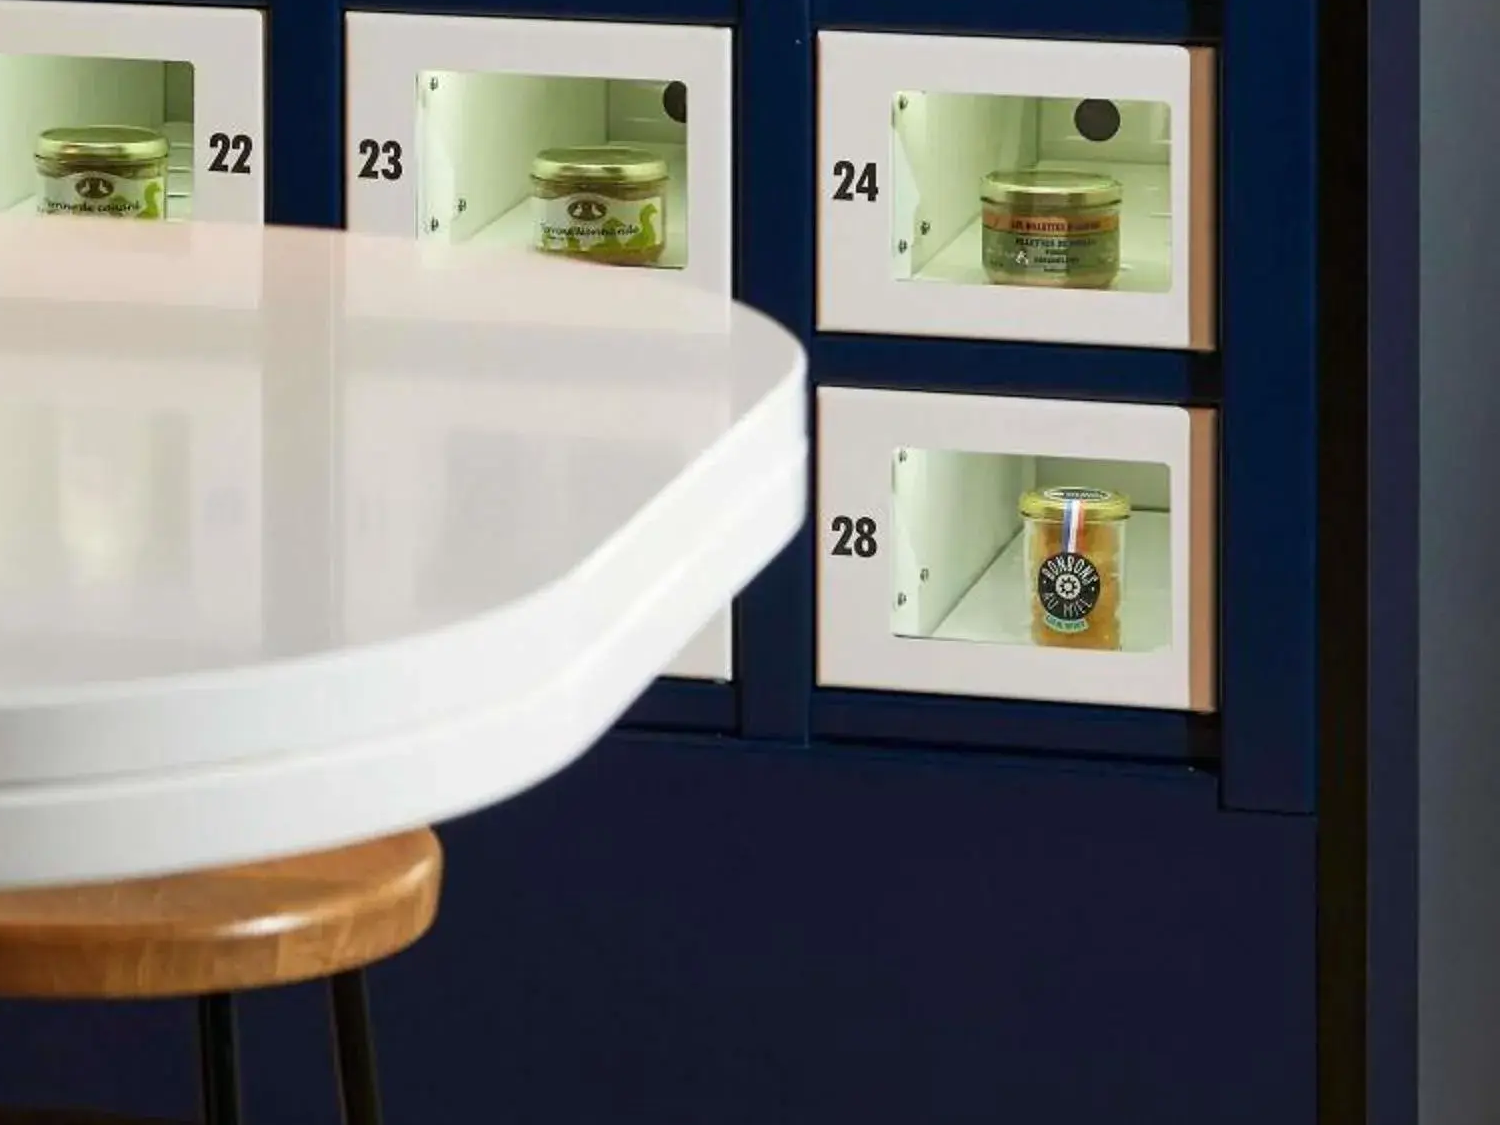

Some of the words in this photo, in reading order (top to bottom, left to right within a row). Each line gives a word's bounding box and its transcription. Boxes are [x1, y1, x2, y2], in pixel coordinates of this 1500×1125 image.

[208, 132, 253, 174] 22
[358, 138, 403, 181] 23
[832, 160, 879, 202] 24
[831, 515, 878, 558] 28
